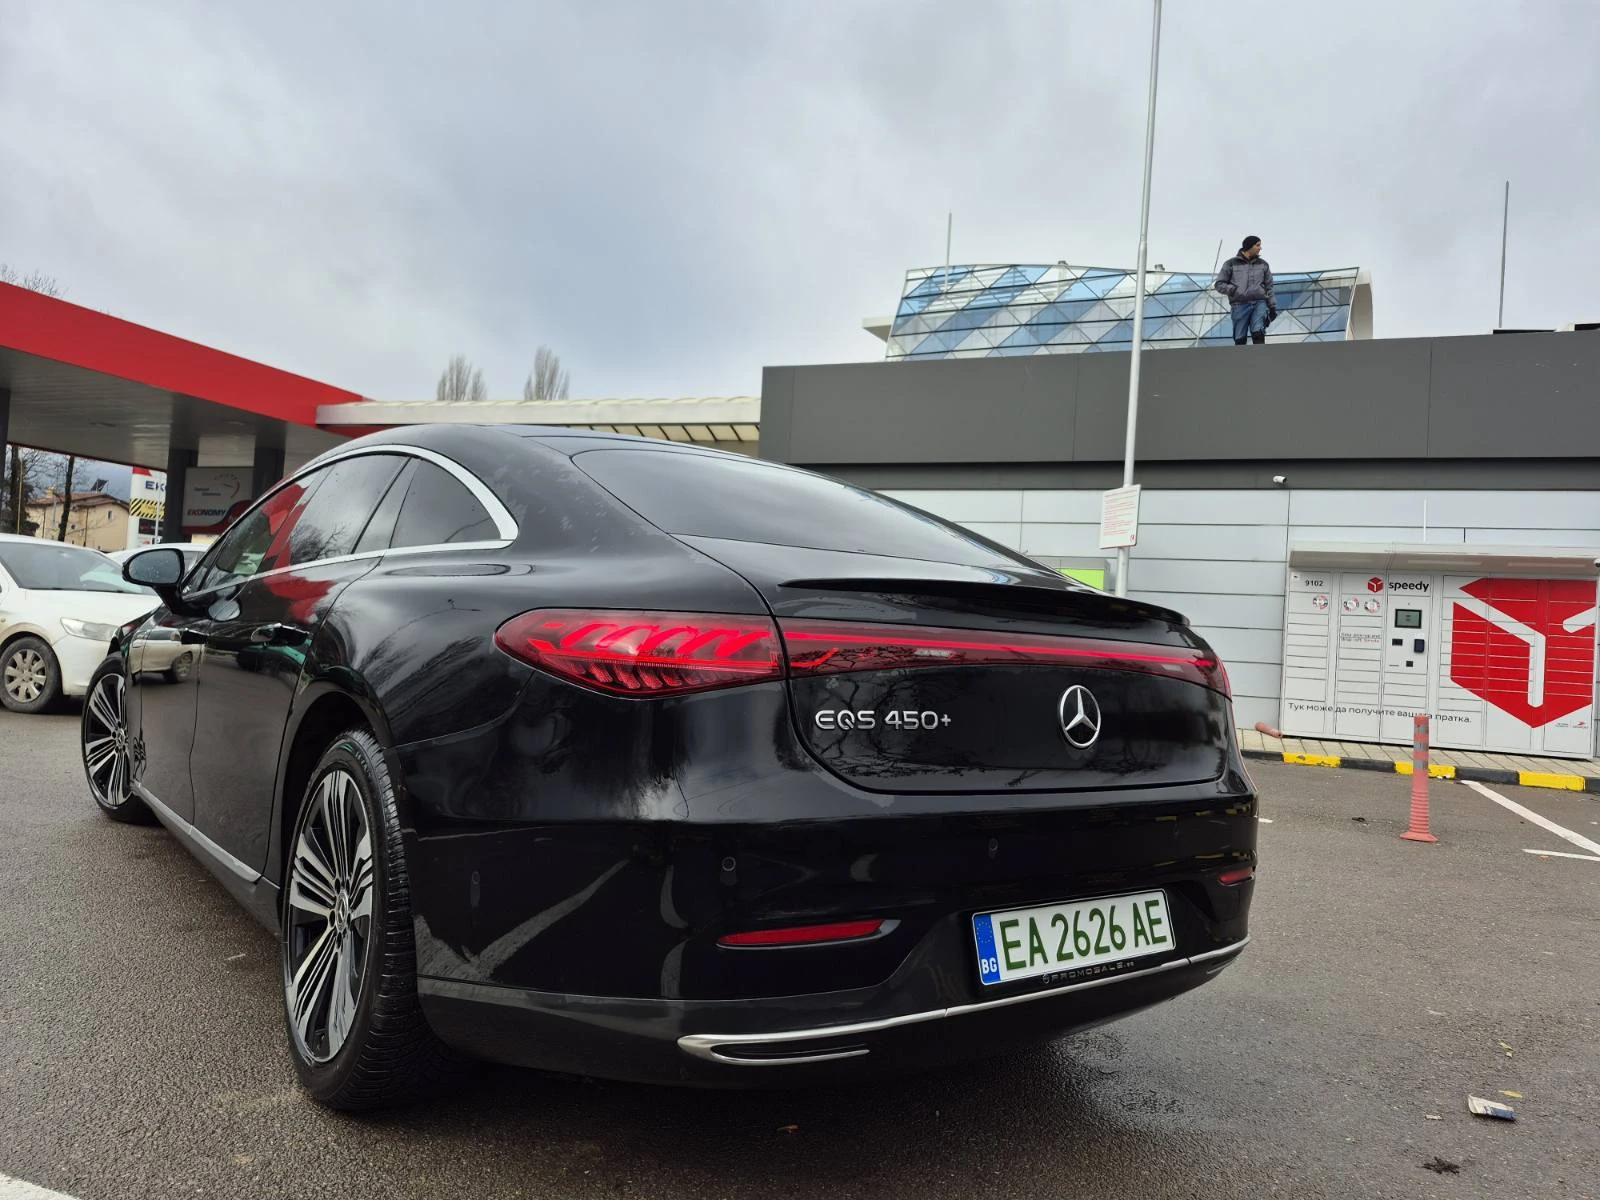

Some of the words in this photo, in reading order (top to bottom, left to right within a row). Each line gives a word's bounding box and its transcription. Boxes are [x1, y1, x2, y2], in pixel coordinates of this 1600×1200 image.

[145, 480, 167, 492] EK
[187, 508, 226, 517] EKONOMY
[1388, 580, 1429, 593] speedy
[815, 709, 876, 730] EQS
[884, 710, 952, 730] 450+
[1288, 702, 1305, 711] Тук
[1306, 703, 1333, 712] може
[1335, 705, 1347, 714] да
[1348, 706, 1396, 716] получите
[1397, 709, 1433, 719] ваша
[1435, 713, 1472, 723] пратка.
[999, 917, 1049, 971] EA
[1050, 904, 1127, 963] 2626
[1132, 899, 1168, 948] AE
[981, 957, 998, 974] BG
